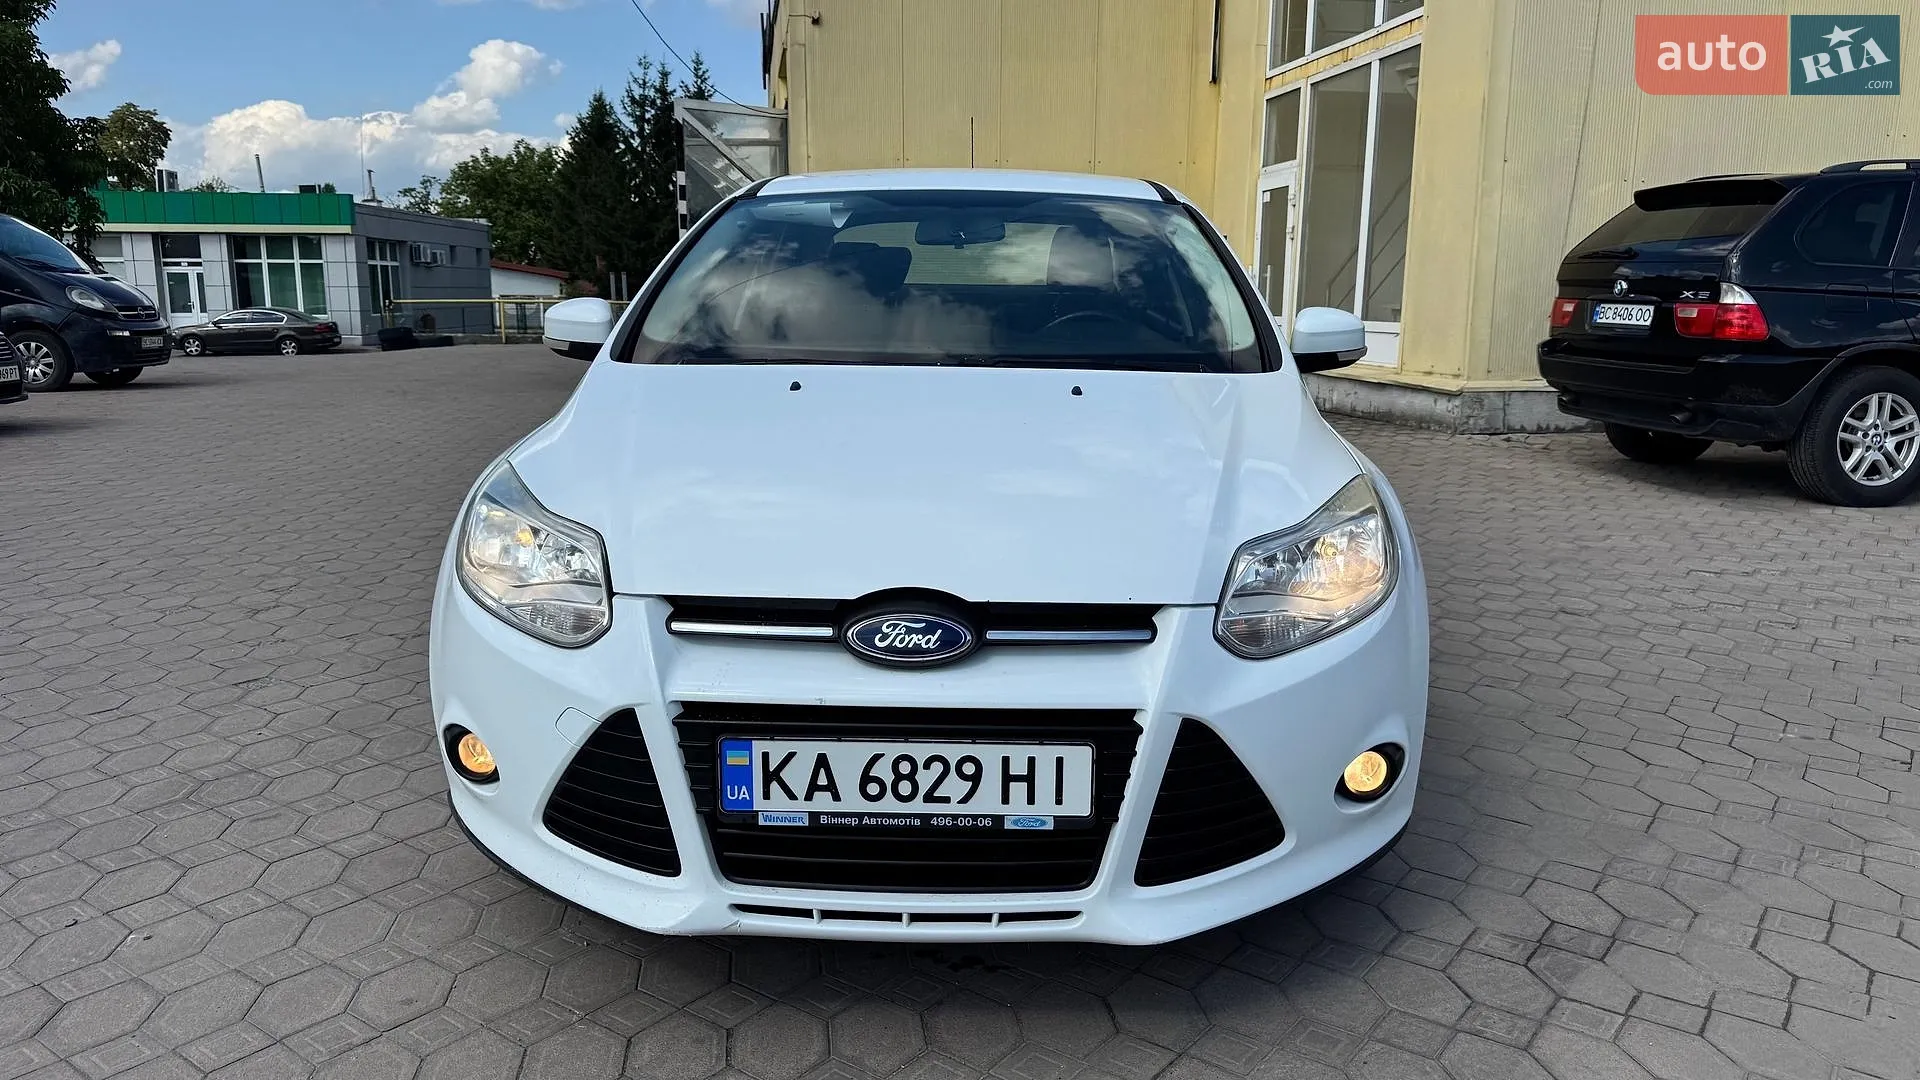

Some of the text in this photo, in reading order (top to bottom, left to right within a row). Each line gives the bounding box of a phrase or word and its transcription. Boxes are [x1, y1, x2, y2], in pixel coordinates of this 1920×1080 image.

[1598, 306, 1612, 320] BC
[1611, 306, 1635, 321] 8406
[874, 620, 943, 649] Ford
[761, 750, 1064, 806] KA 6829 HI
[727, 785, 750, 800] UA
[820, 815, 992, 827] Віннер Автомотів 496-00-06
